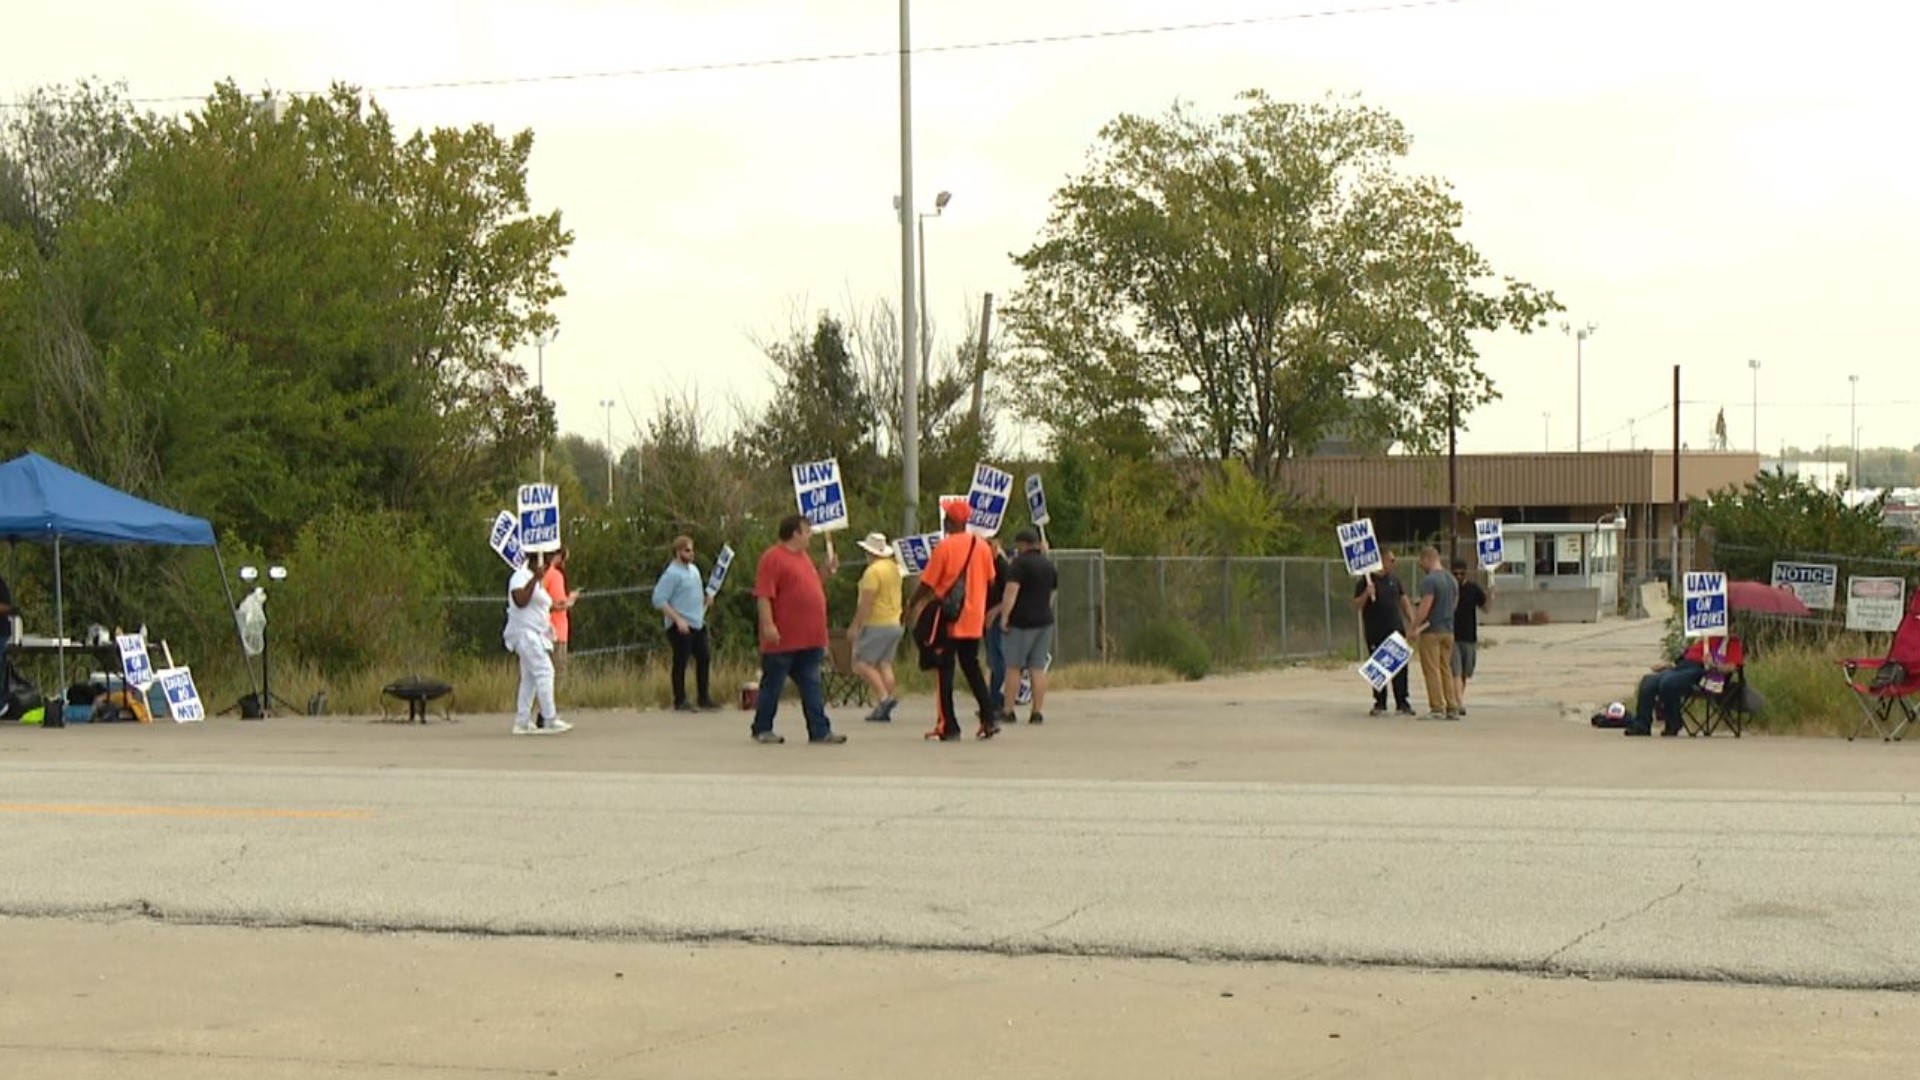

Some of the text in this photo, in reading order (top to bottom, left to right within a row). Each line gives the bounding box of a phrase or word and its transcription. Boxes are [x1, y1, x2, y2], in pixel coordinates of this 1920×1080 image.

[797, 462, 833, 485] UAW
[977, 466, 1010, 492] UAW
[521, 486, 554, 504] UAW
[810, 487, 827, 507] ON
[977, 493, 993, 509] ON
[530, 509, 547, 526] ON
[493, 513, 513, 547] UAW
[1341, 521, 1368, 542] UAW
[1479, 521, 1499, 534] UAW
[1353, 541, 1365, 556] ON
[1688, 574, 1723, 591] UAW
[1776, 566, 1833, 584] NOTICE
[1696, 596, 1712, 612] ON
[1689, 611, 1725, 631] STRIKE
